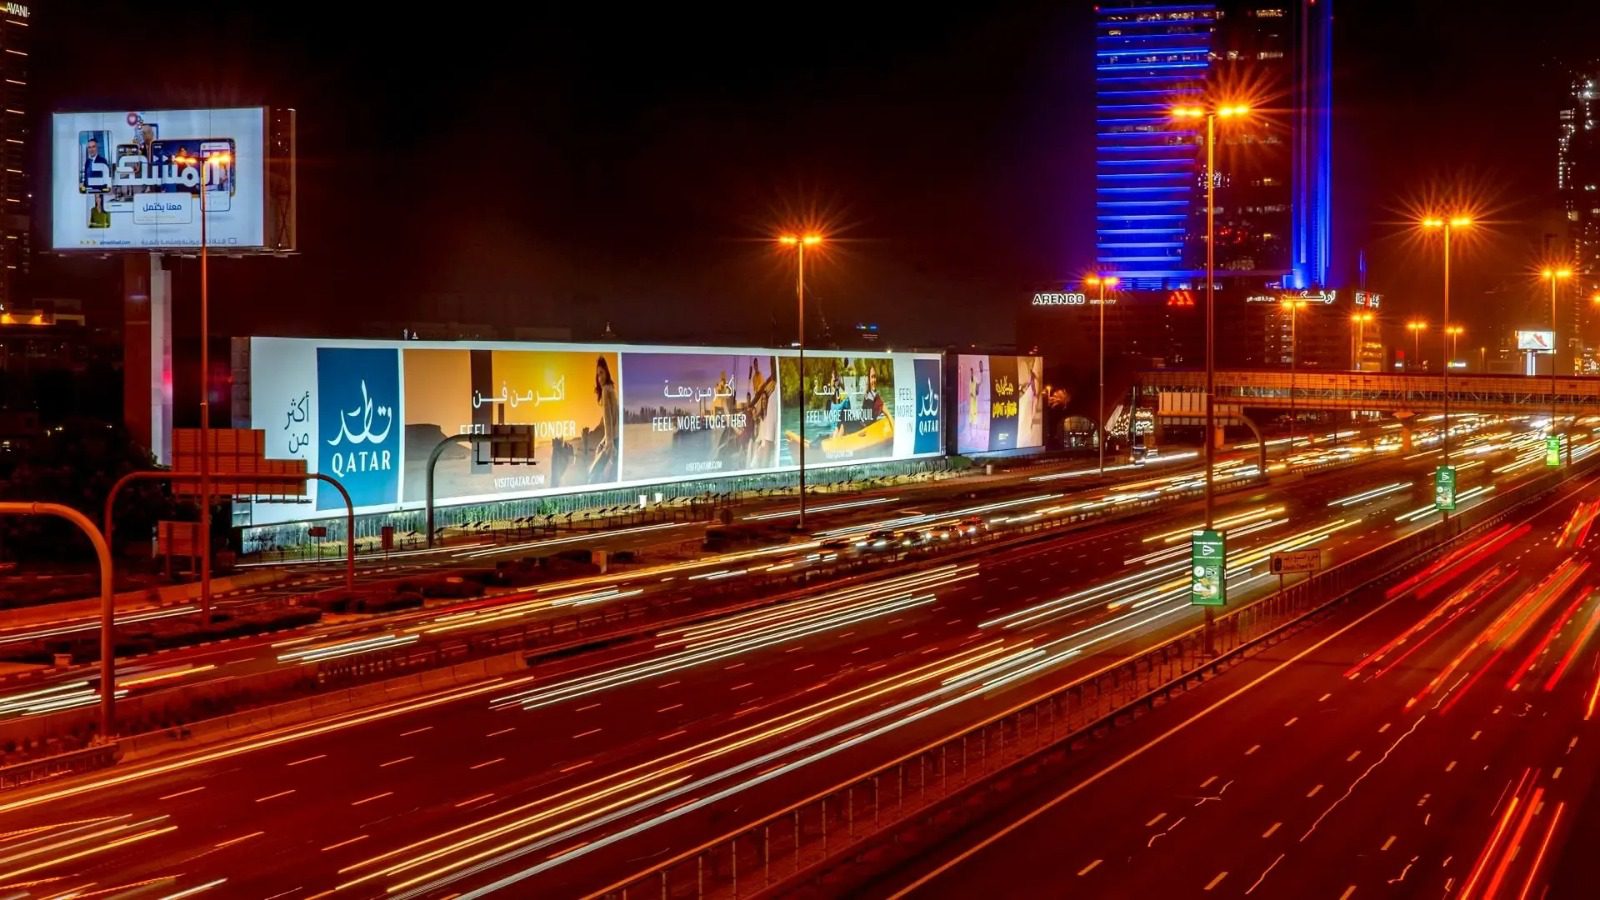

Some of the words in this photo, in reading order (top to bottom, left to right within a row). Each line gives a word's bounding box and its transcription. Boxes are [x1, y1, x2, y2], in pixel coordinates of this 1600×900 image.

[143, 202, 165, 212] يكتمل
[166, 202, 182, 211] معنا
[1032, 293, 1085, 305] ARENCO
[472, 380, 508, 409] فن
[510, 389, 533, 408] من
[535, 375, 565, 407] أكثر
[663, 379, 693, 403] جمعة
[695, 386, 711, 402] من
[899, 388, 913, 401] FEEL
[284, 391, 310, 430] أكثر
[327, 379, 392, 446] قطر
[806, 410, 821, 423] FEEL
[823, 409, 842, 422] MORE
[844, 408, 874, 423] TRANQUIL
[896, 404, 913, 418] MORE
[652, 416, 673, 432] FEEL
[677, 415, 700, 430] MORE
[704, 413, 747, 429] TOGETHER
[919, 419, 939, 436] QATAR
[288, 432, 309, 454] من
[331, 449, 391, 478] QATAR
[494, 475, 545, 488] VISITQATAR.COM
